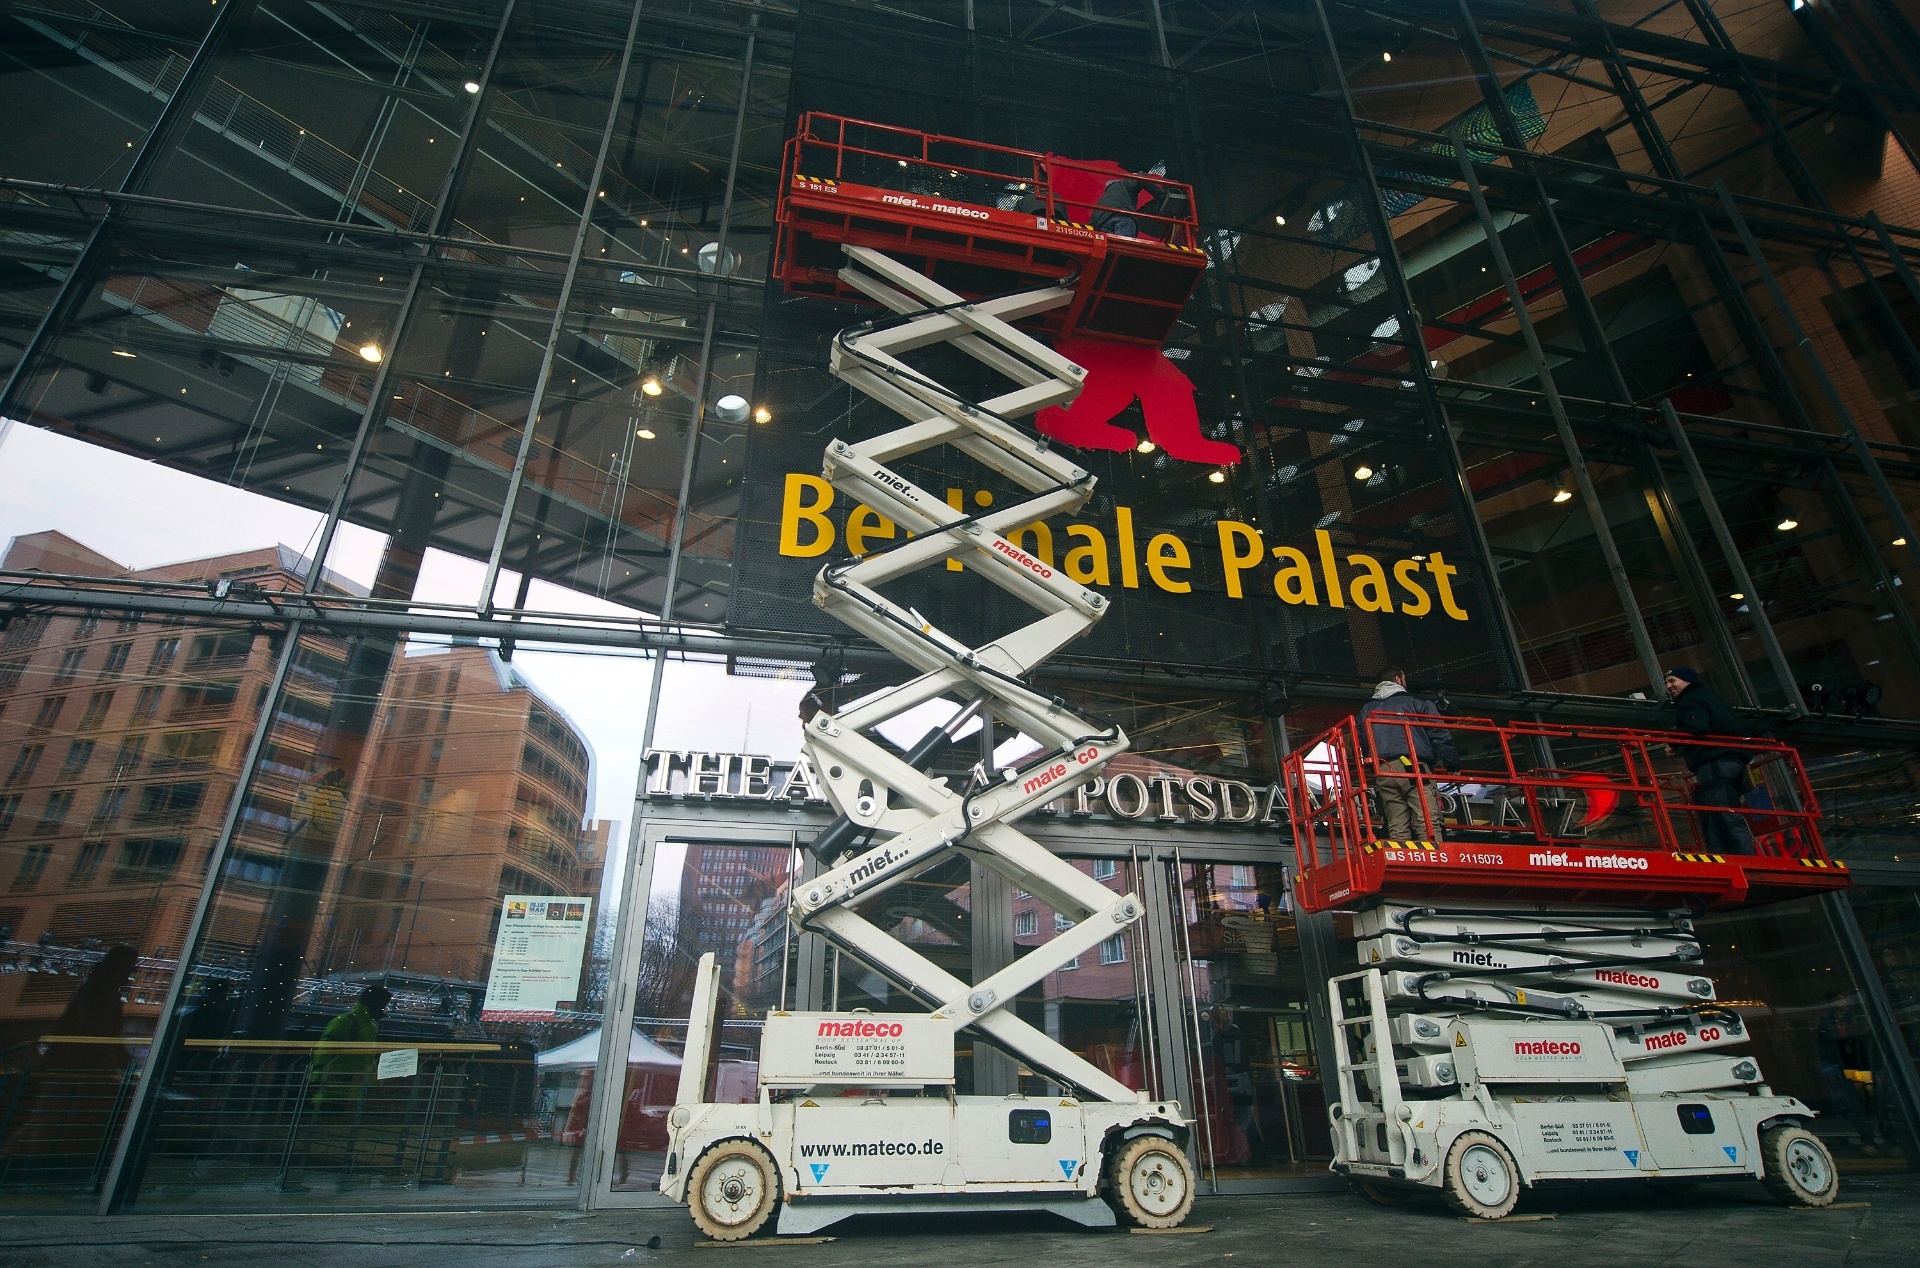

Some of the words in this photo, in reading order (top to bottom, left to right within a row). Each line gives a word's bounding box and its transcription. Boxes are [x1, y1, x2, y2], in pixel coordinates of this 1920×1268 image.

[883, 194, 929, 209] miet...
[932, 202, 989, 219] mateco
[1056, 226, 1093, 238] 21150074
[873, 469, 918, 501] miet...
[779, 473, 1192, 593] Benale
[1217, 520, 1469, 621] Palast
[992, 540, 1052, 579] mateco
[643, 747, 829, 802] THEA
[1023, 763, 1067, 794] mate
[1077, 747, 1099, 765] co
[1397, 850, 1405, 861] S
[1408, 851, 1426, 862] 151
[1460, 853, 1503, 865] 2115073
[1530, 852, 1583, 867] miet...
[1585, 854, 1648, 869] mateco
[849, 849, 909, 885] miet...
[1452, 950, 1507, 968] miet...
[1595, 968, 1660, 989] mateco
[818, 1020, 903, 1037] mateco
[1645, 1030, 1687, 1050] mate
[1699, 1027, 1720, 1042] co
[1515, 1040, 1581, 1055] mateco
[801, 1139, 944, 1157] www.mateco.de
